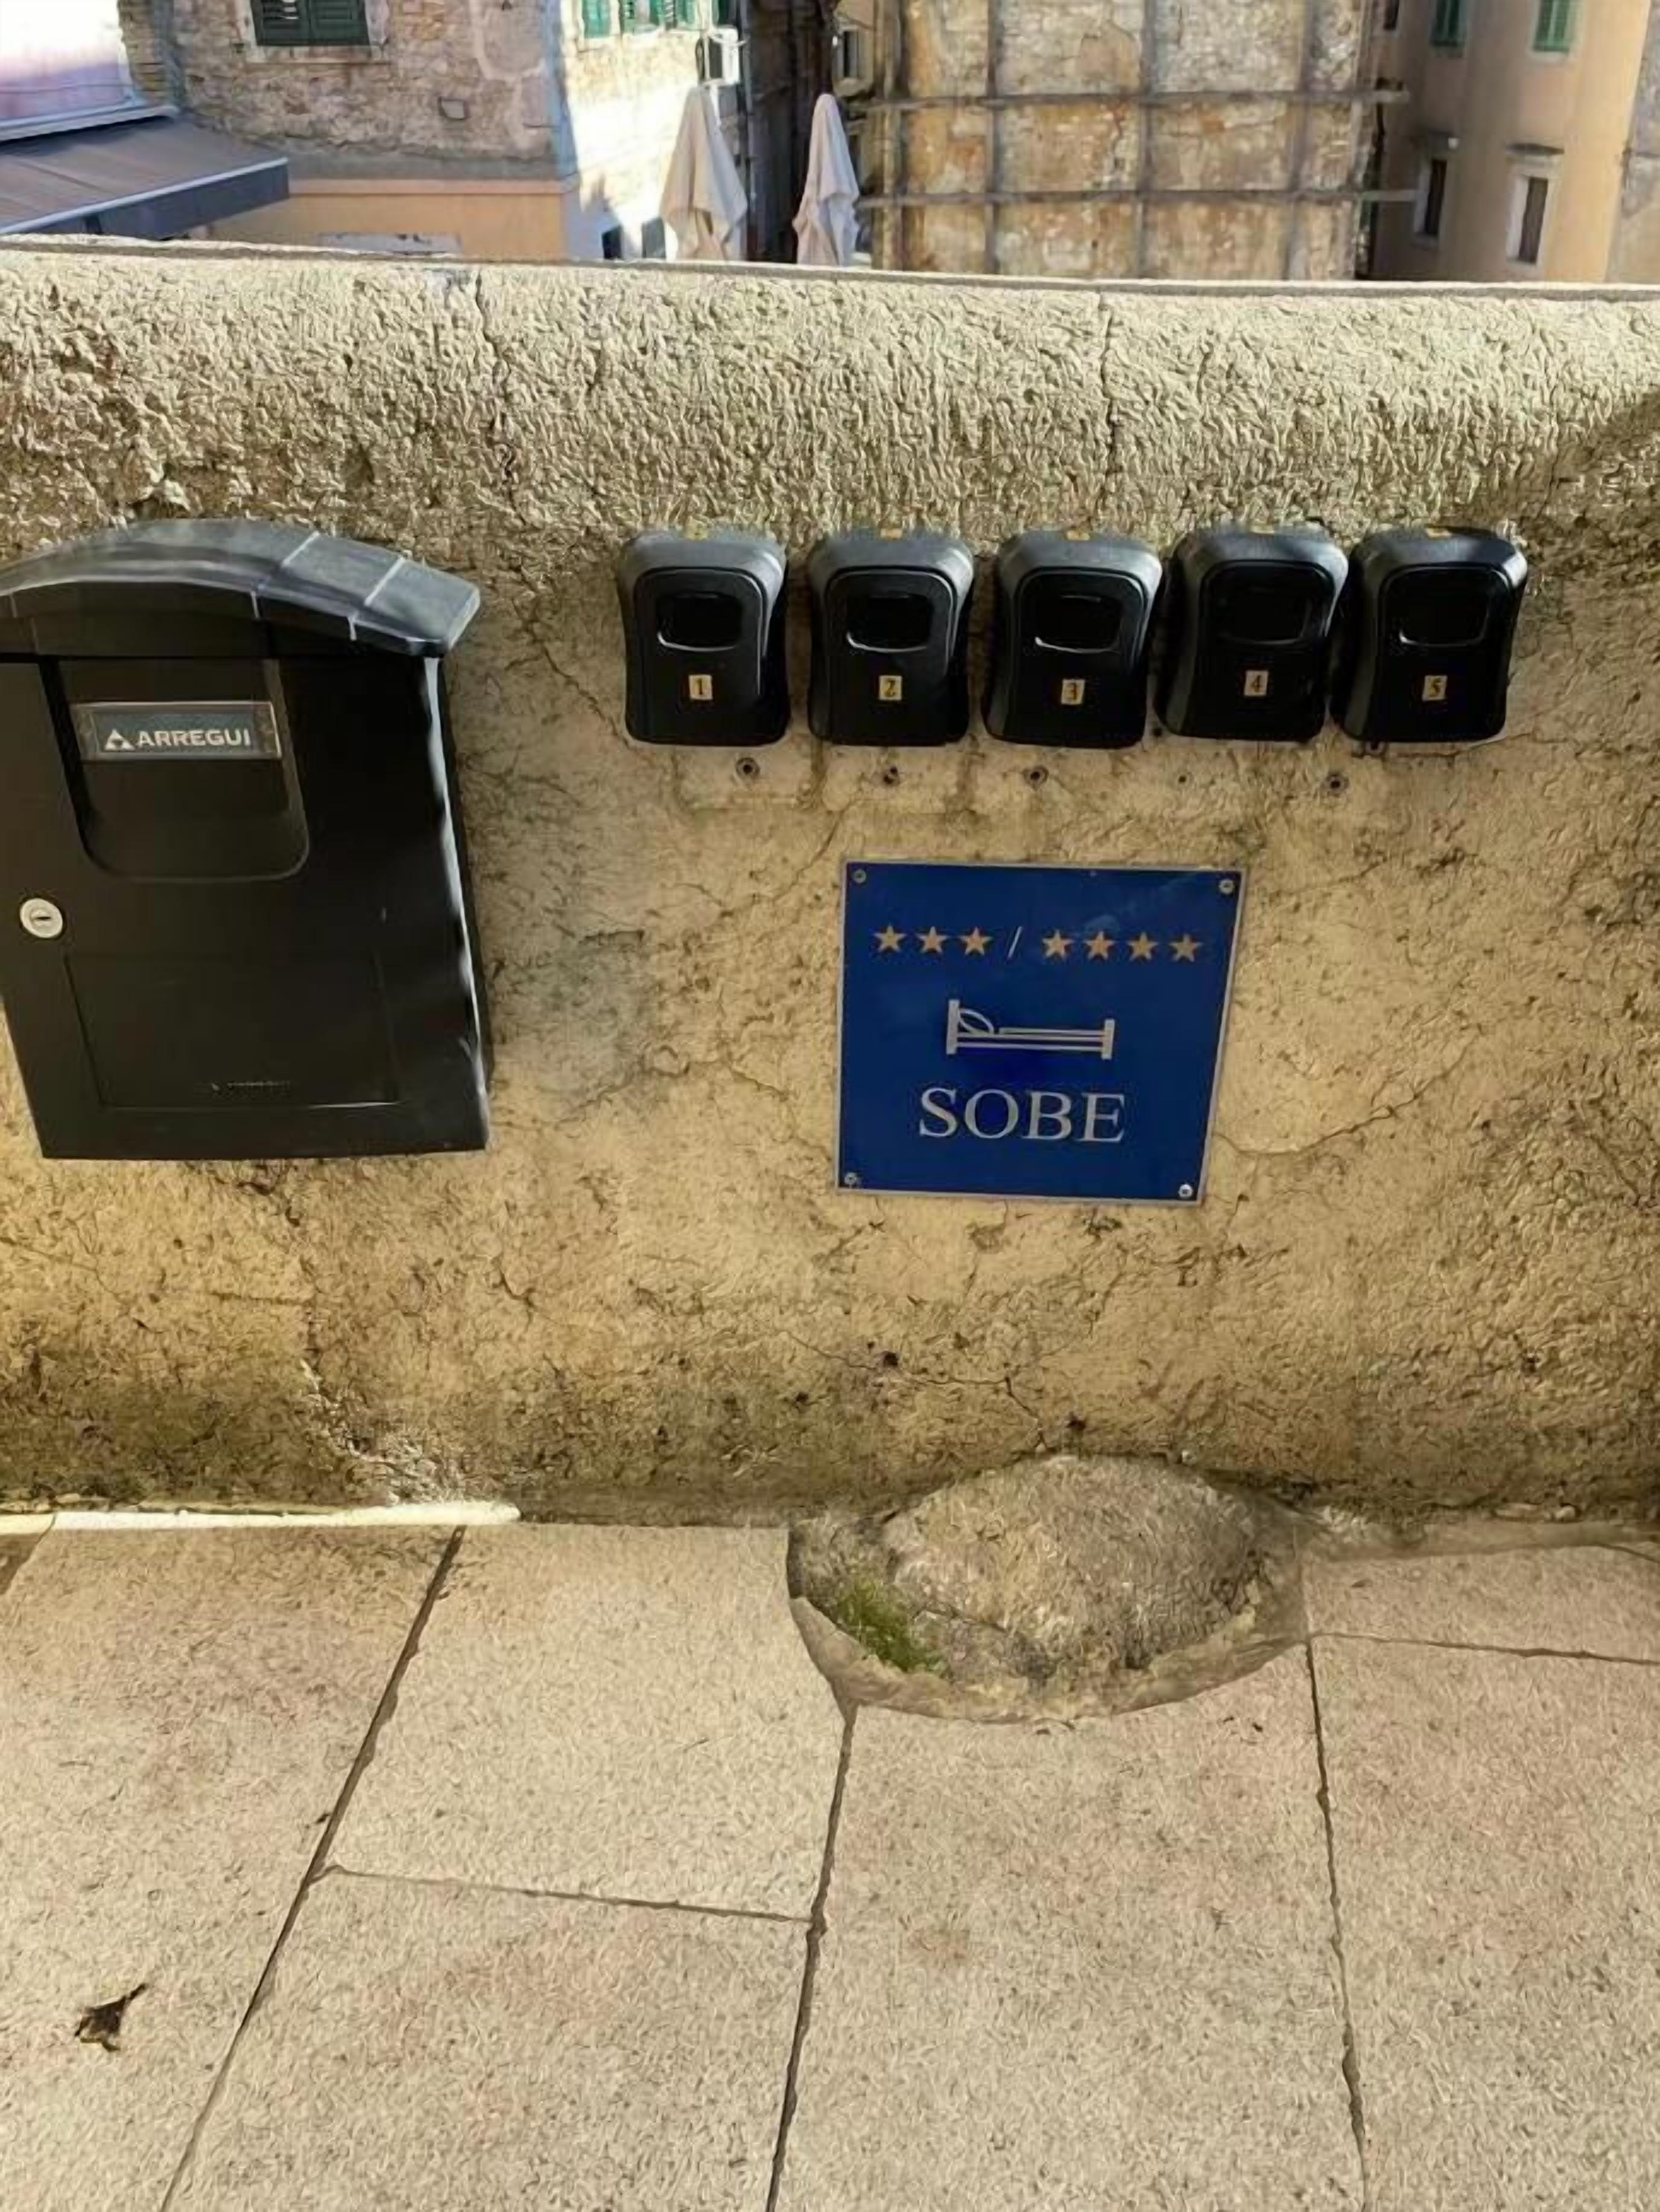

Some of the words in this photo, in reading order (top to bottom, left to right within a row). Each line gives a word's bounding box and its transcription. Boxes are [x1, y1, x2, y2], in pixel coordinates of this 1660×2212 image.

[886, 678, 896, 697] 2
[1067, 683, 1079, 701] 3
[1249, 674, 1262, 693] 4
[1428, 678, 1442, 698] 5
[137, 728, 251, 747] ARREGUI
[918, 1087, 1126, 1143] SOBE
